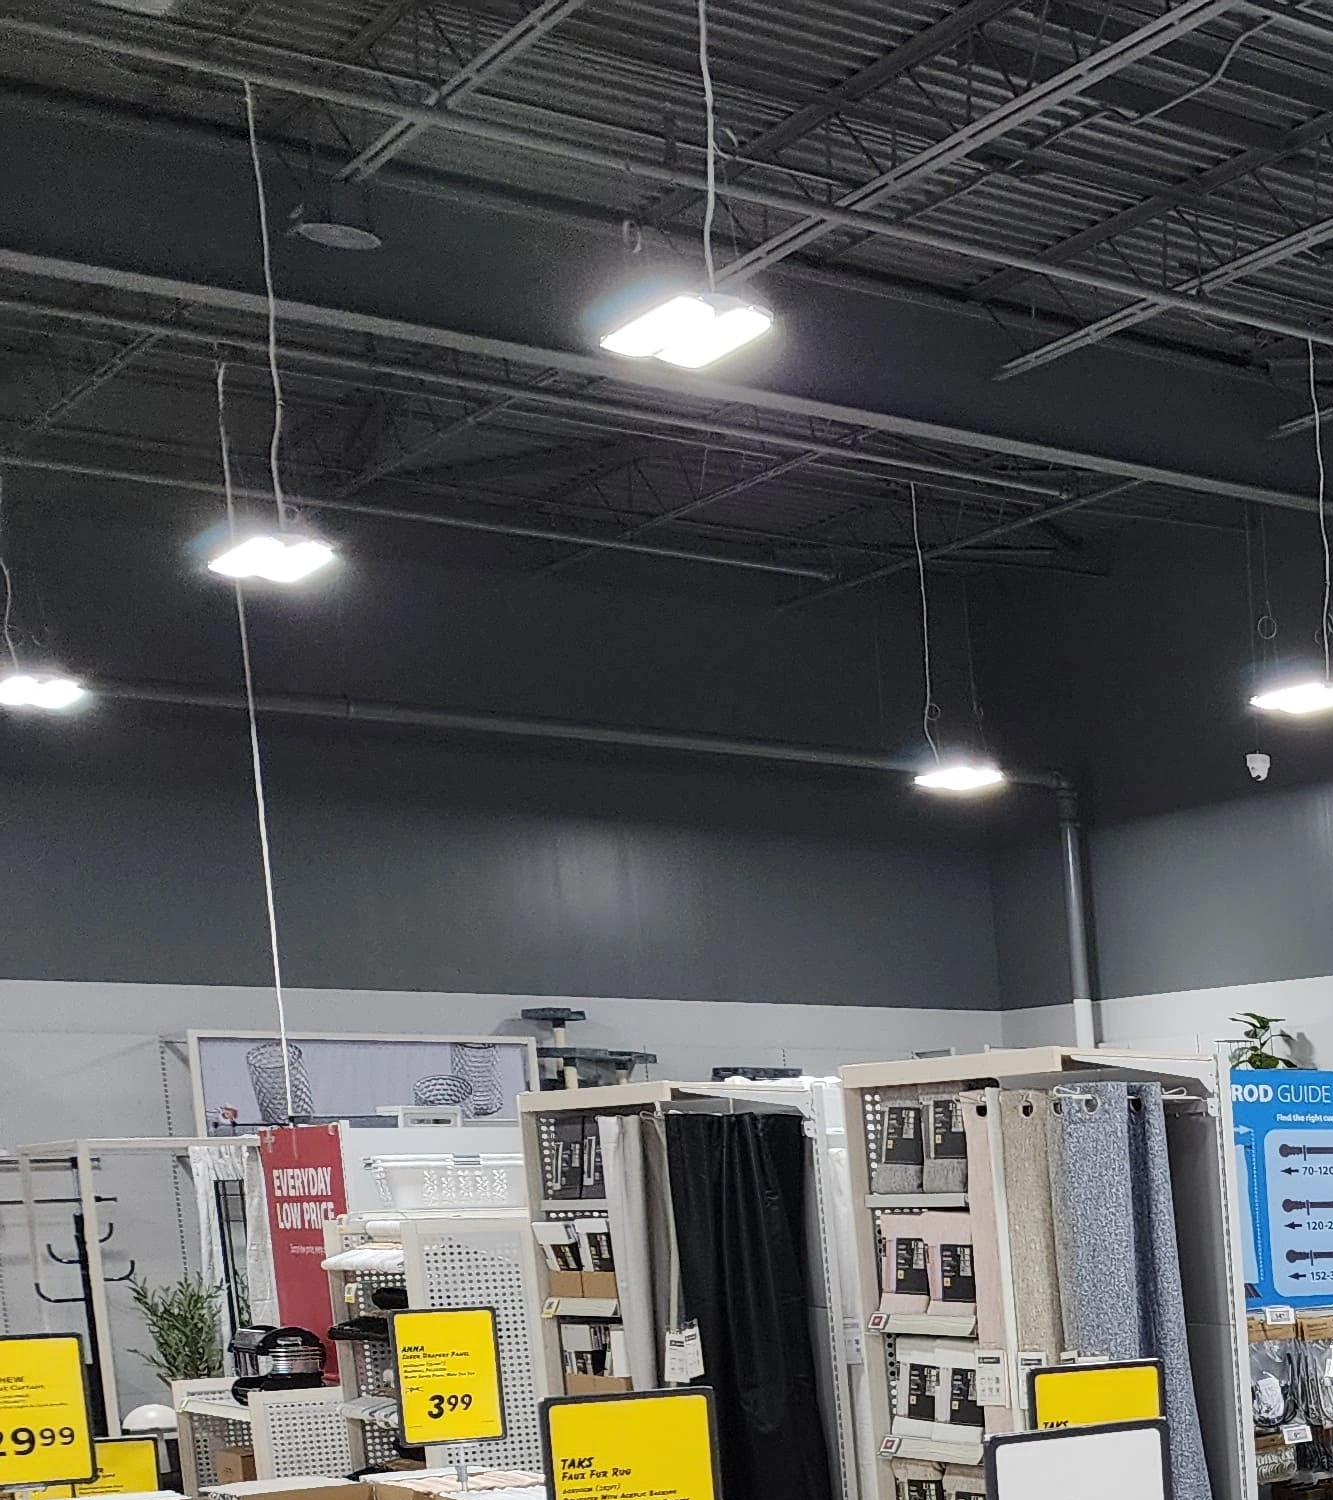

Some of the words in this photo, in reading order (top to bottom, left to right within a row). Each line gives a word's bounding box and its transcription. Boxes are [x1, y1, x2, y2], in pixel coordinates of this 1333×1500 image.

[1230, 1083, 1274, 1103] ROD
[1277, 1084, 1332, 1103] GUIDE
[1276, 1112, 1291, 1122] Find
[1293, 1113, 1305, 1122] the
[1305, 1113, 1322, 1125] right
[272, 1166, 332, 1197] EVERYDAY
[276, 1202, 302, 1230] LOW
[302, 1201, 337, 1230] PRICE
[427, 1393, 473, 1420] 399
[560, 1456, 595, 1471] TAKS
